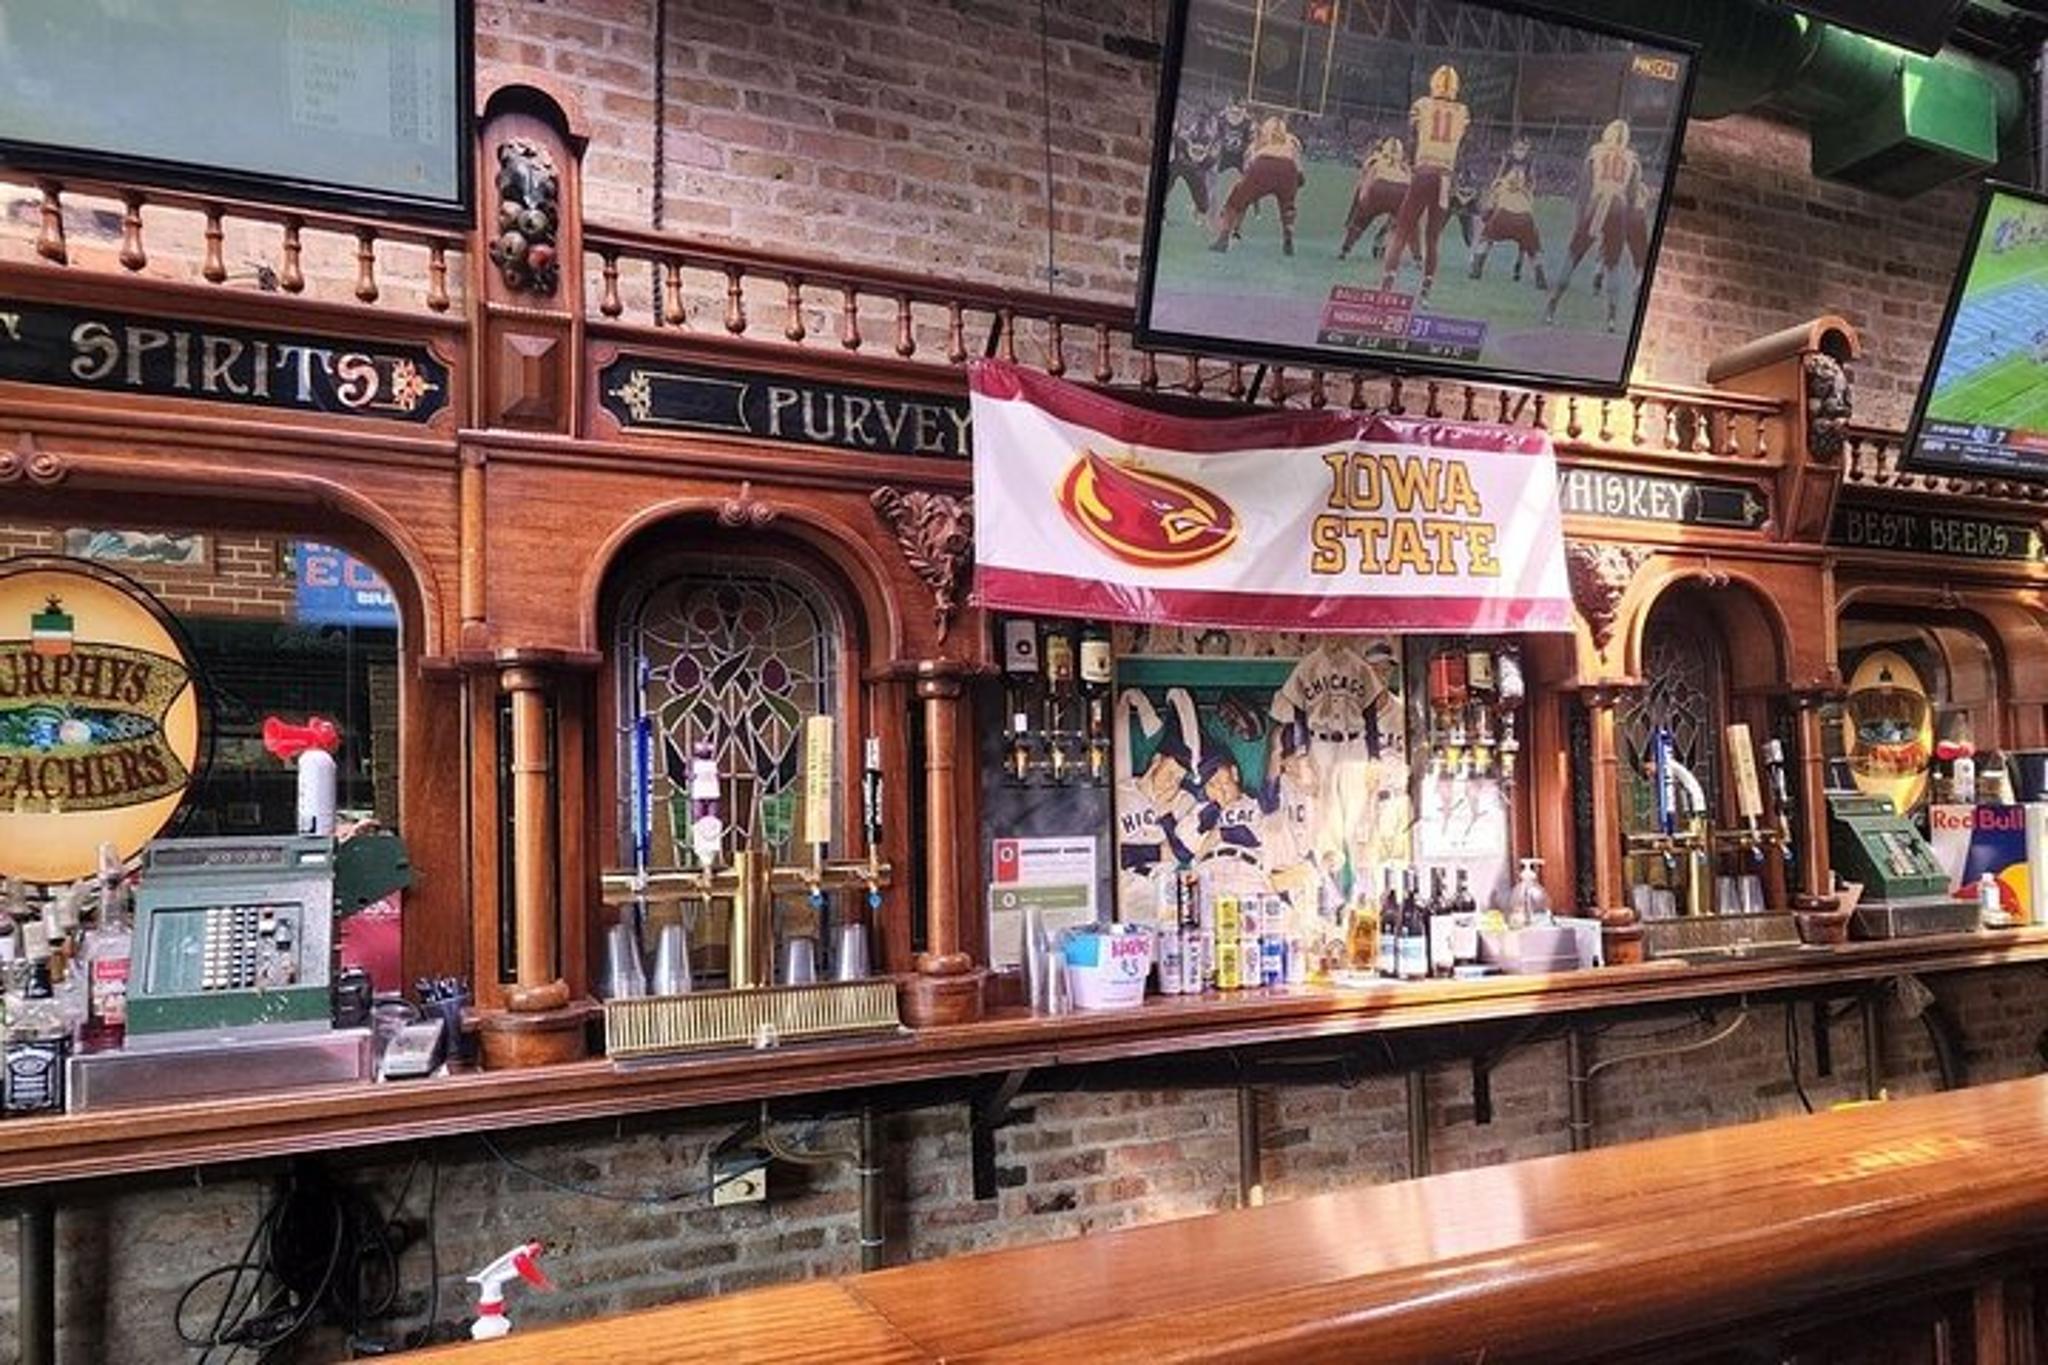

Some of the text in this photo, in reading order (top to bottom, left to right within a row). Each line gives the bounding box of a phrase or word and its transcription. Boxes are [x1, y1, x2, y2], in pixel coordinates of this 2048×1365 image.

[70, 321, 380, 408] SPIRITS
[768, 386, 972, 456] PURVEY
[1322, 451, 1482, 517] IOWA
[1311, 514, 1502, 577] STATE
[1848, 511, 2009, 555] BEST BEERS
[1305, 673, 1366, 701] CHICAGO
[1933, 809, 2024, 831] Red Bull
